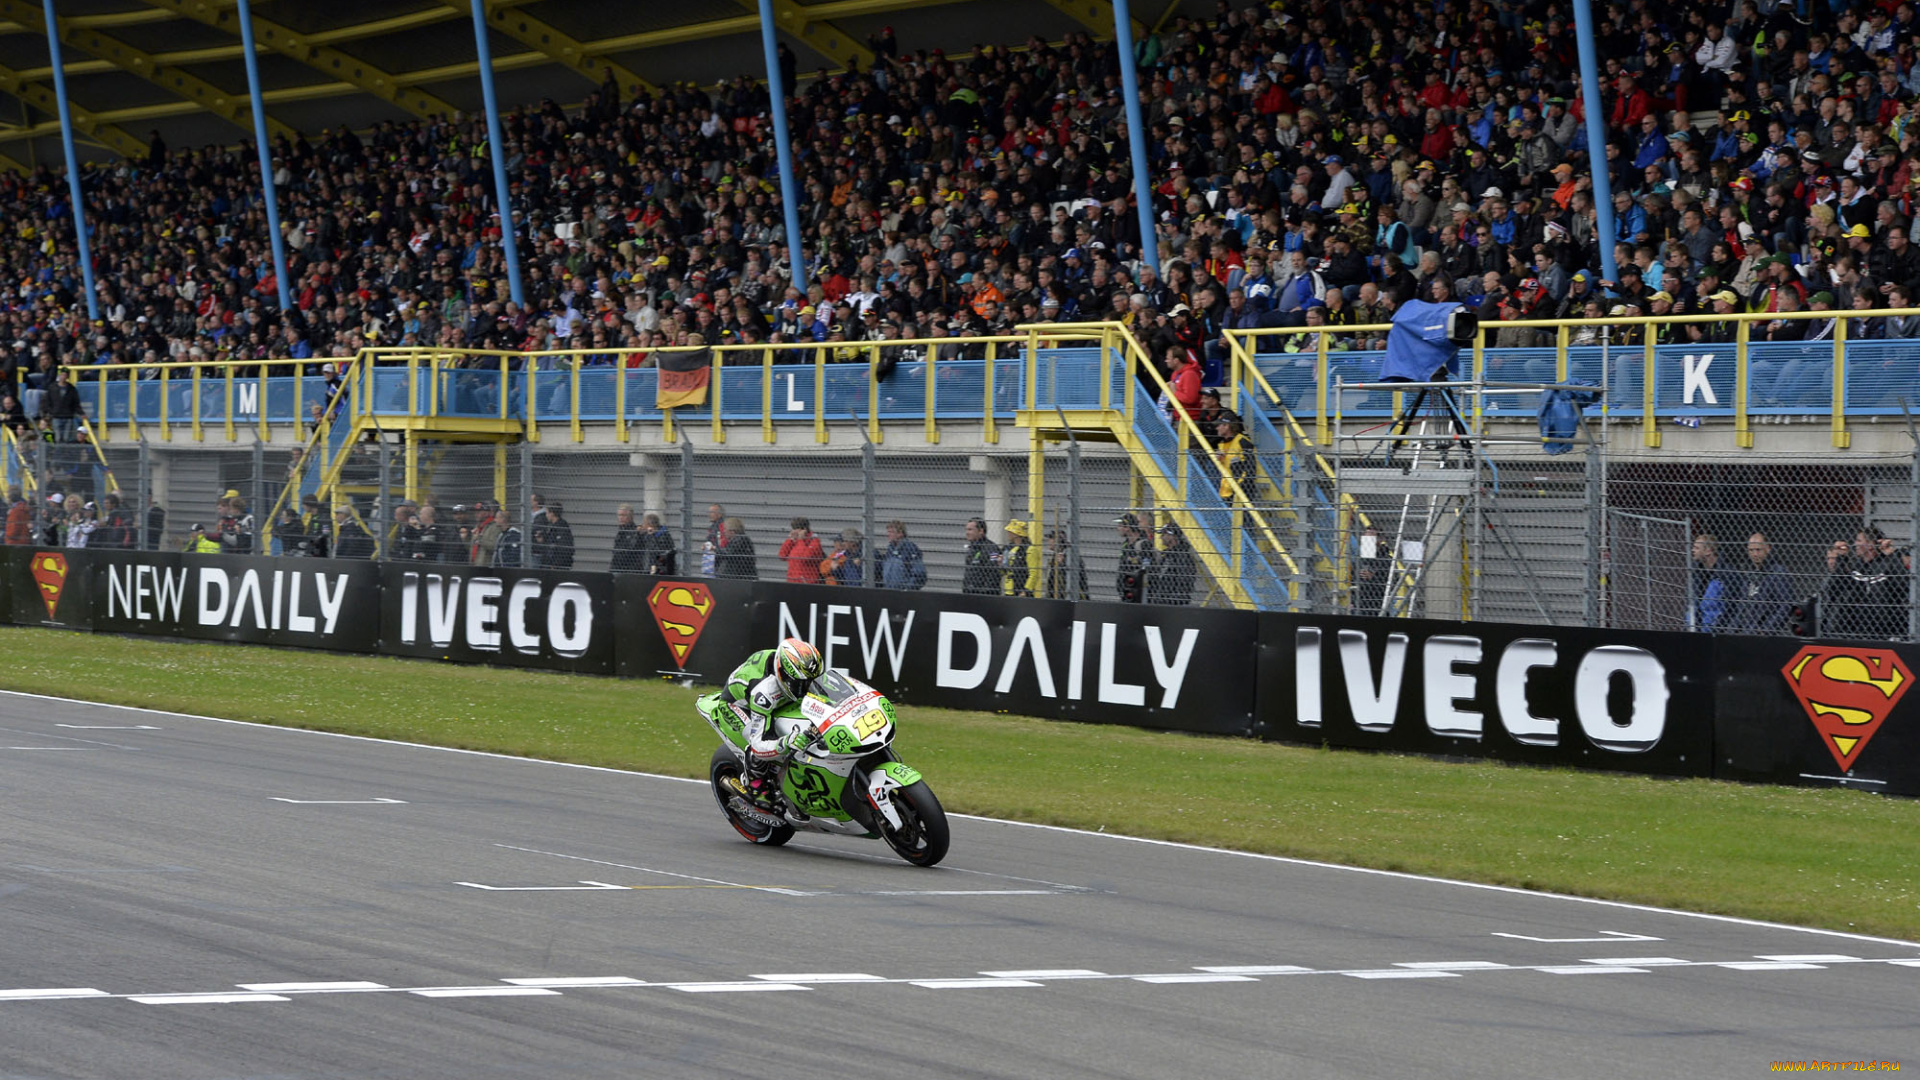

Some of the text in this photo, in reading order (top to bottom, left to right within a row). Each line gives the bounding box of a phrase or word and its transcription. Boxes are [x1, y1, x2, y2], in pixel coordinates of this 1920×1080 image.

[239, 383, 257, 414] M
[786, 373, 805, 411] L
[1683, 354, 1718, 405] K
[108, 564, 349, 634] NEW DAILY
[401, 570, 593, 658] IVECO
[779, 602, 1200, 709] NEW DAILY
[829, 692, 876, 722] BARRACUDA
[1295, 626, 1670, 753] IVECO
[829, 729, 848, 747] GO
[852, 708, 888, 741] 19
